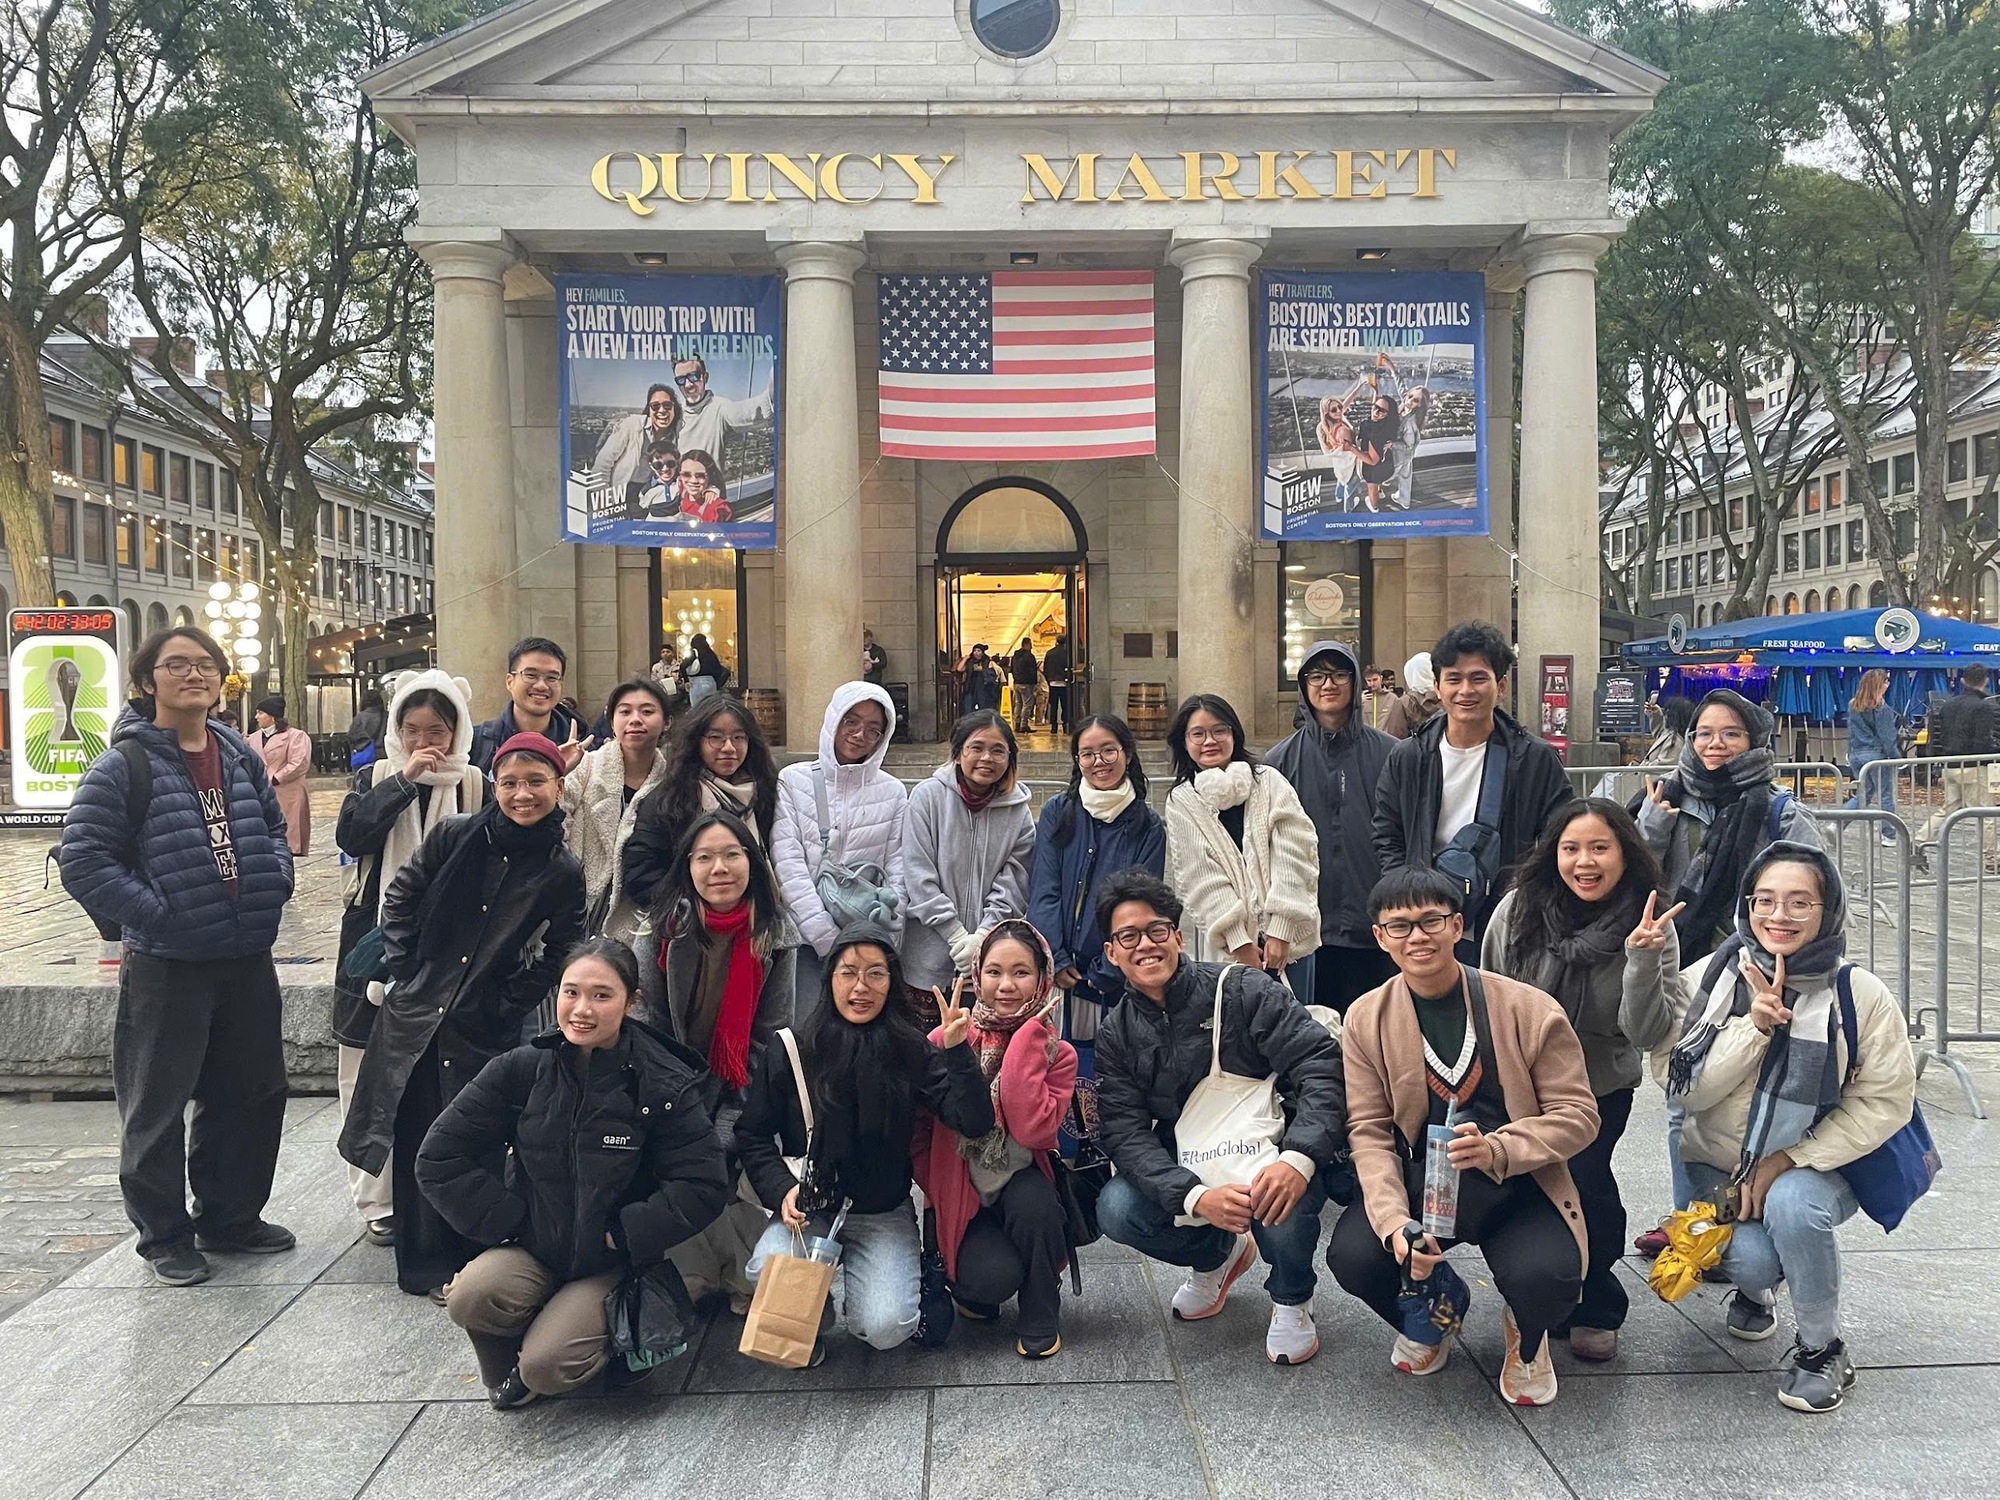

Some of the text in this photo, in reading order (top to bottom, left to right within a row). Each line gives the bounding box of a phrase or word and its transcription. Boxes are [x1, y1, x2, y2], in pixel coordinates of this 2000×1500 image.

[591, 148, 1457, 216] QUINCY MARKET
[566, 287, 628, 304] HEY FAMILIES,
[1268, 283, 1335, 300] HEY TRAVELERS,
[566, 304, 756, 334] START YOUR TRIP WITH
[1268, 301, 1470, 328] BOSTON'S BEST COCKTAILS
[567, 332, 580, 359] A
[582, 332, 628, 360] VIEW
[631, 333, 673, 361] THAT
[676, 334, 729, 361] NEVER
[1267, 327, 1298, 352] ARE
[1300, 328, 1360, 353] SERVED
[1363, 328, 1400, 353] WAY
[590, 482, 628, 511] VIEW
[1285, 474, 1322, 507] VIEW
[592, 503, 627, 519] BOSTON
[1286, 496, 1321, 516] BOSTON
[1762, 639, 1826, 649] FRESH SEAFOOD
[1973, 643, 2000, 652] GREAT
[48, 748, 87, 764] FIFA
[26, 780, 79, 792] BOST
[5, 815, 40, 824] WORLD
[41, 815, 62, 824] CUP
